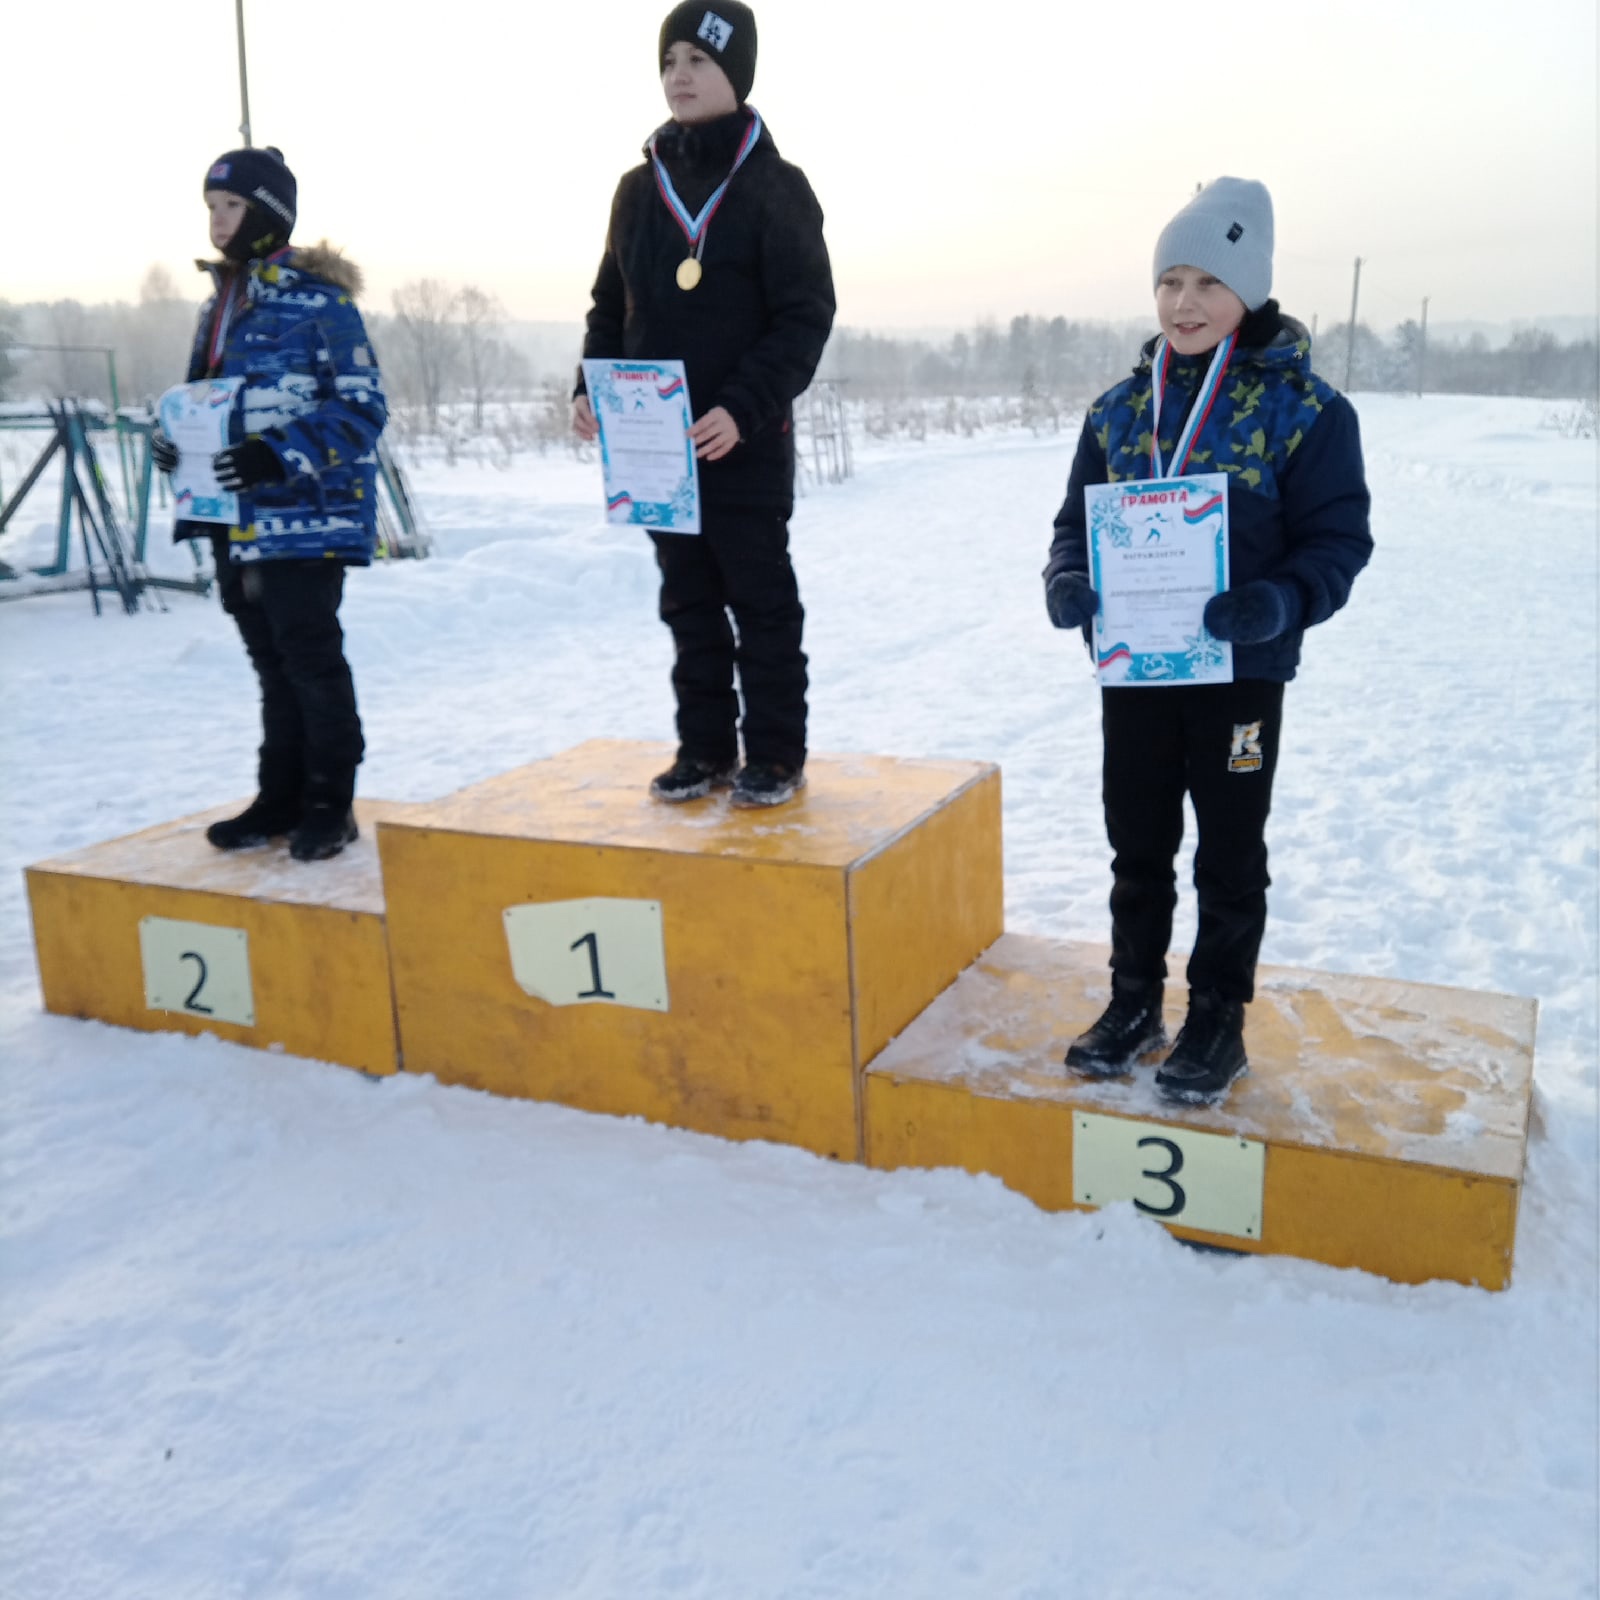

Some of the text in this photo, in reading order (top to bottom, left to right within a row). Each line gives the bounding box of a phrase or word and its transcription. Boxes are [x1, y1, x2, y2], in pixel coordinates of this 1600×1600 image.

[1121, 490, 1189, 508] ГРАМОТА
[179, 951, 214, 1015] 2
[569, 931, 616, 1000] 1
[1133, 1136, 1187, 1217] 3
